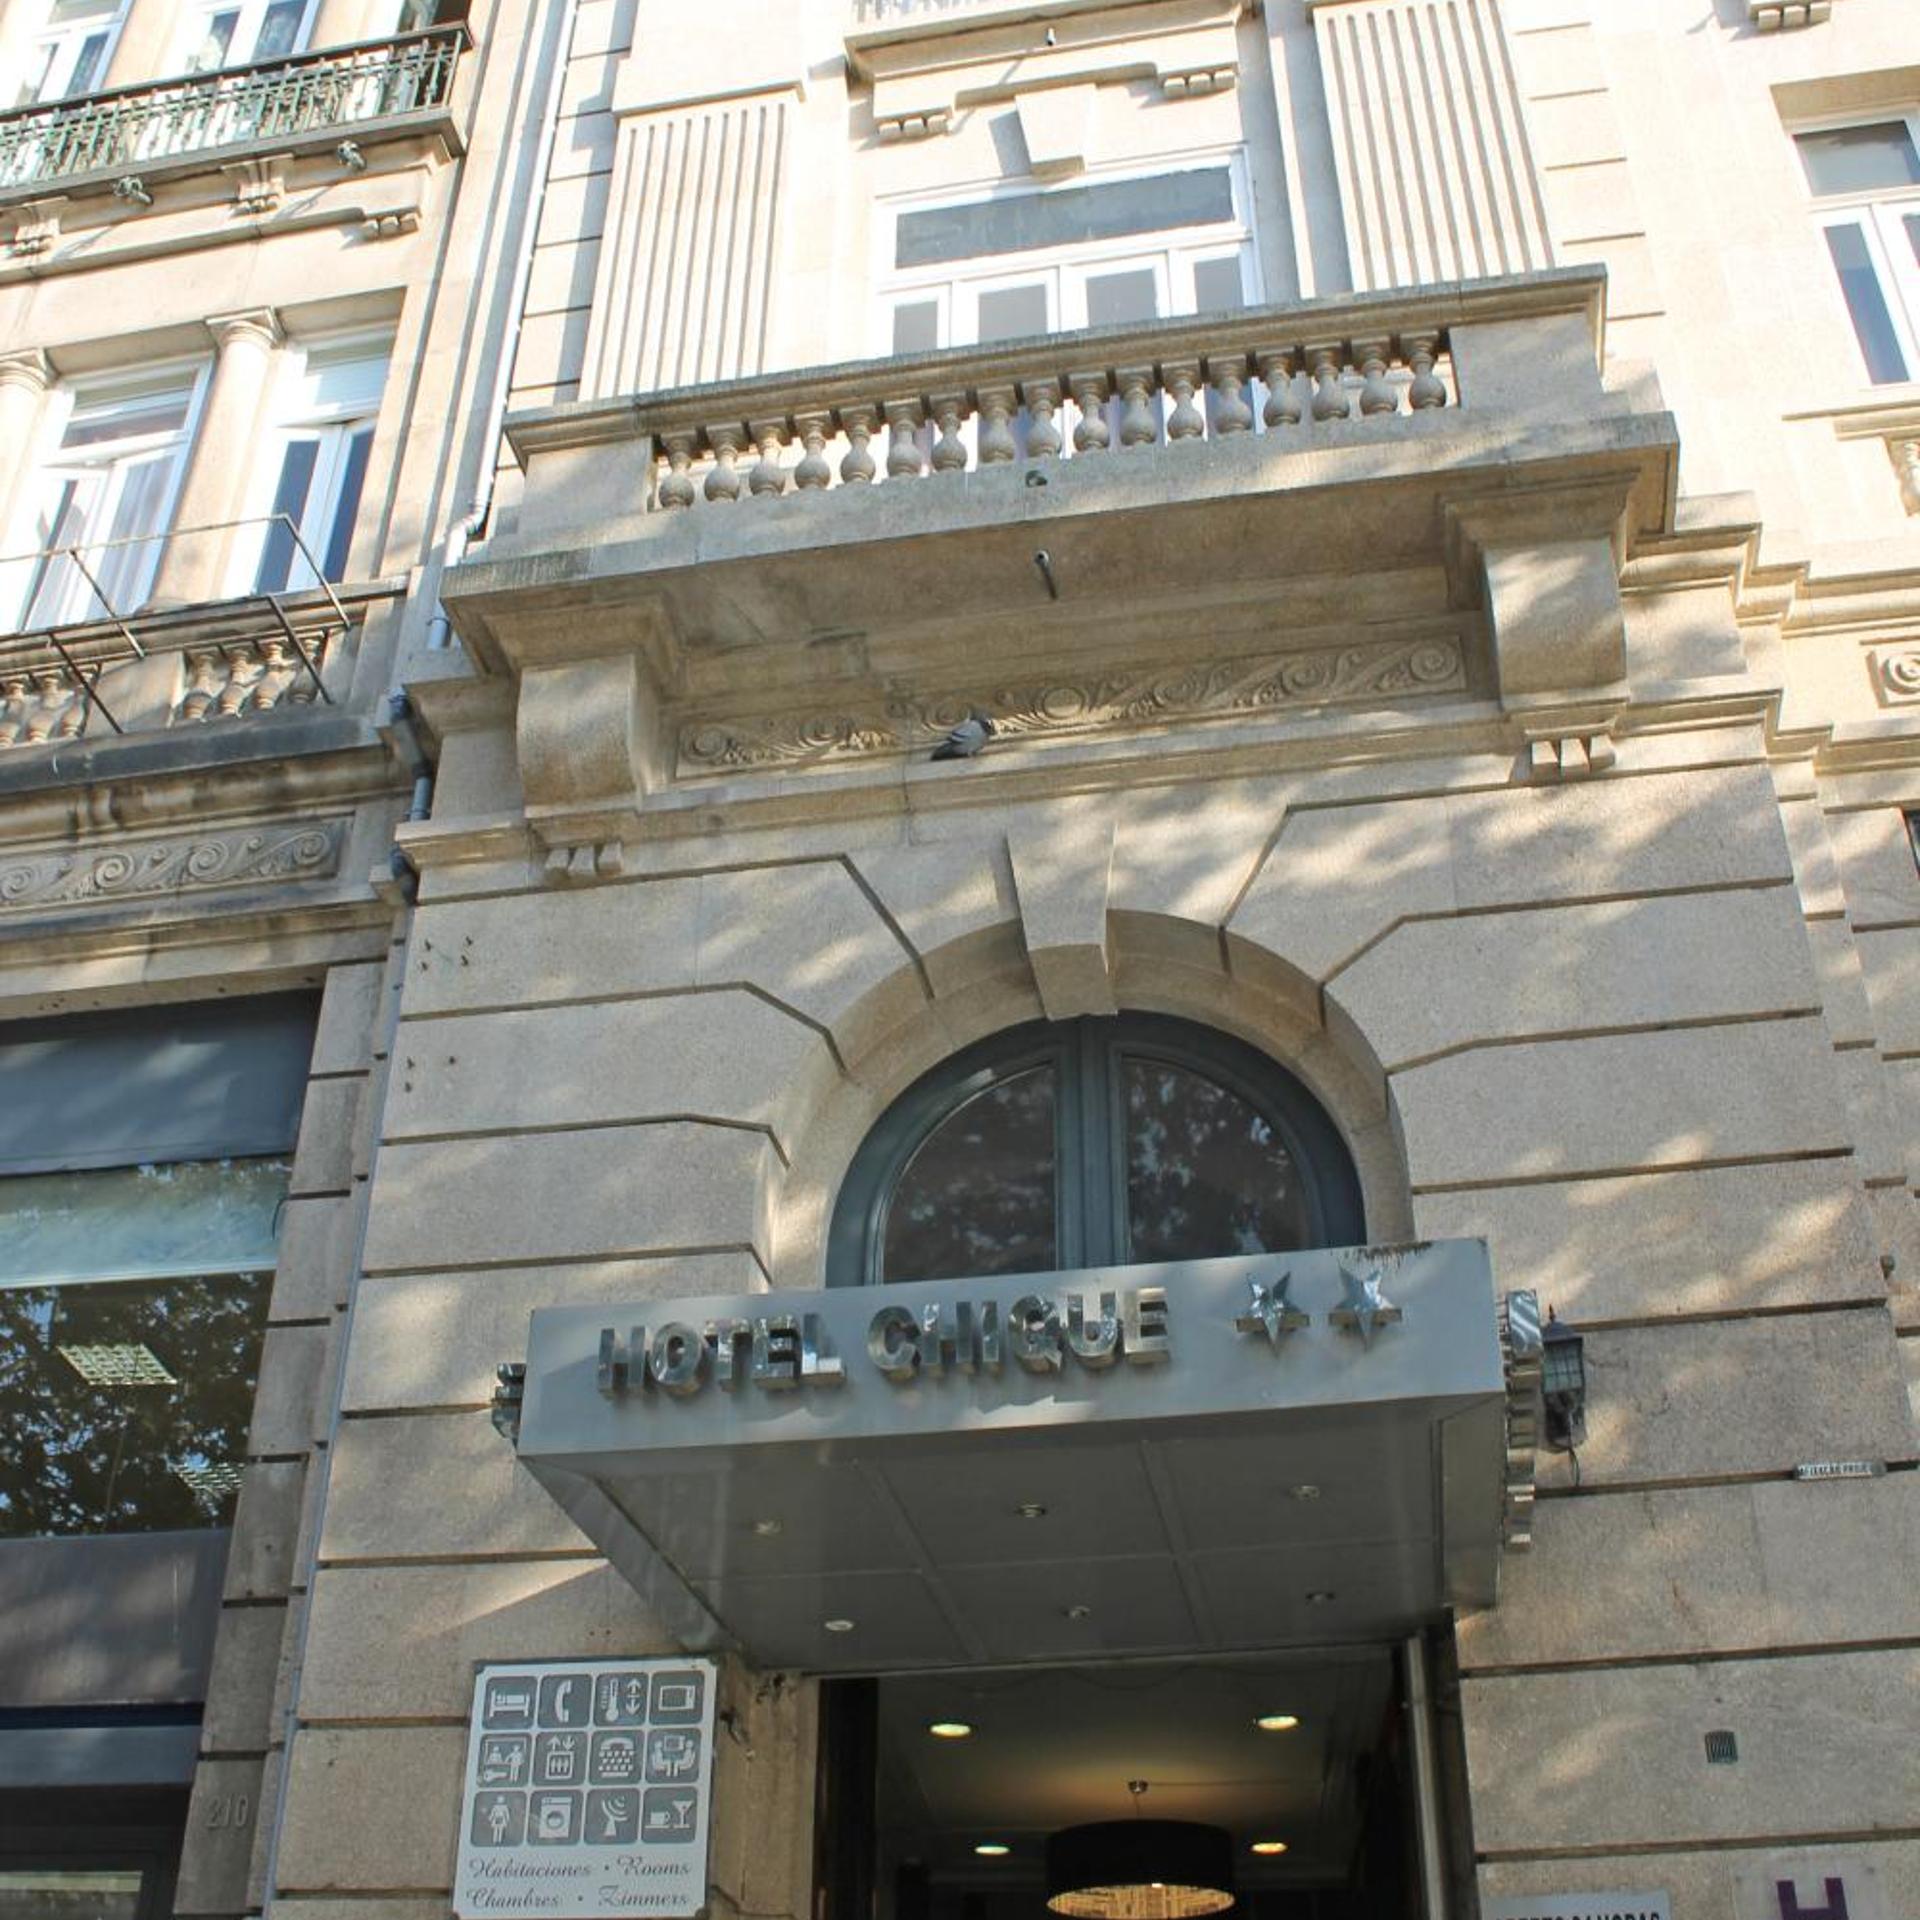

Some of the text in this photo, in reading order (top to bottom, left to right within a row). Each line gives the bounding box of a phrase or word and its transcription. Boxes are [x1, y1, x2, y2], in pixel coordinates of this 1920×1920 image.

[598, 1287, 1169, 1391] HOTEL CHIQUE
[206, 1795, 248, 1829] 210
[469, 1855, 691, 1880] Habitaciones Rooms
[467, 1884, 688, 1909] Chambres Zimmers
